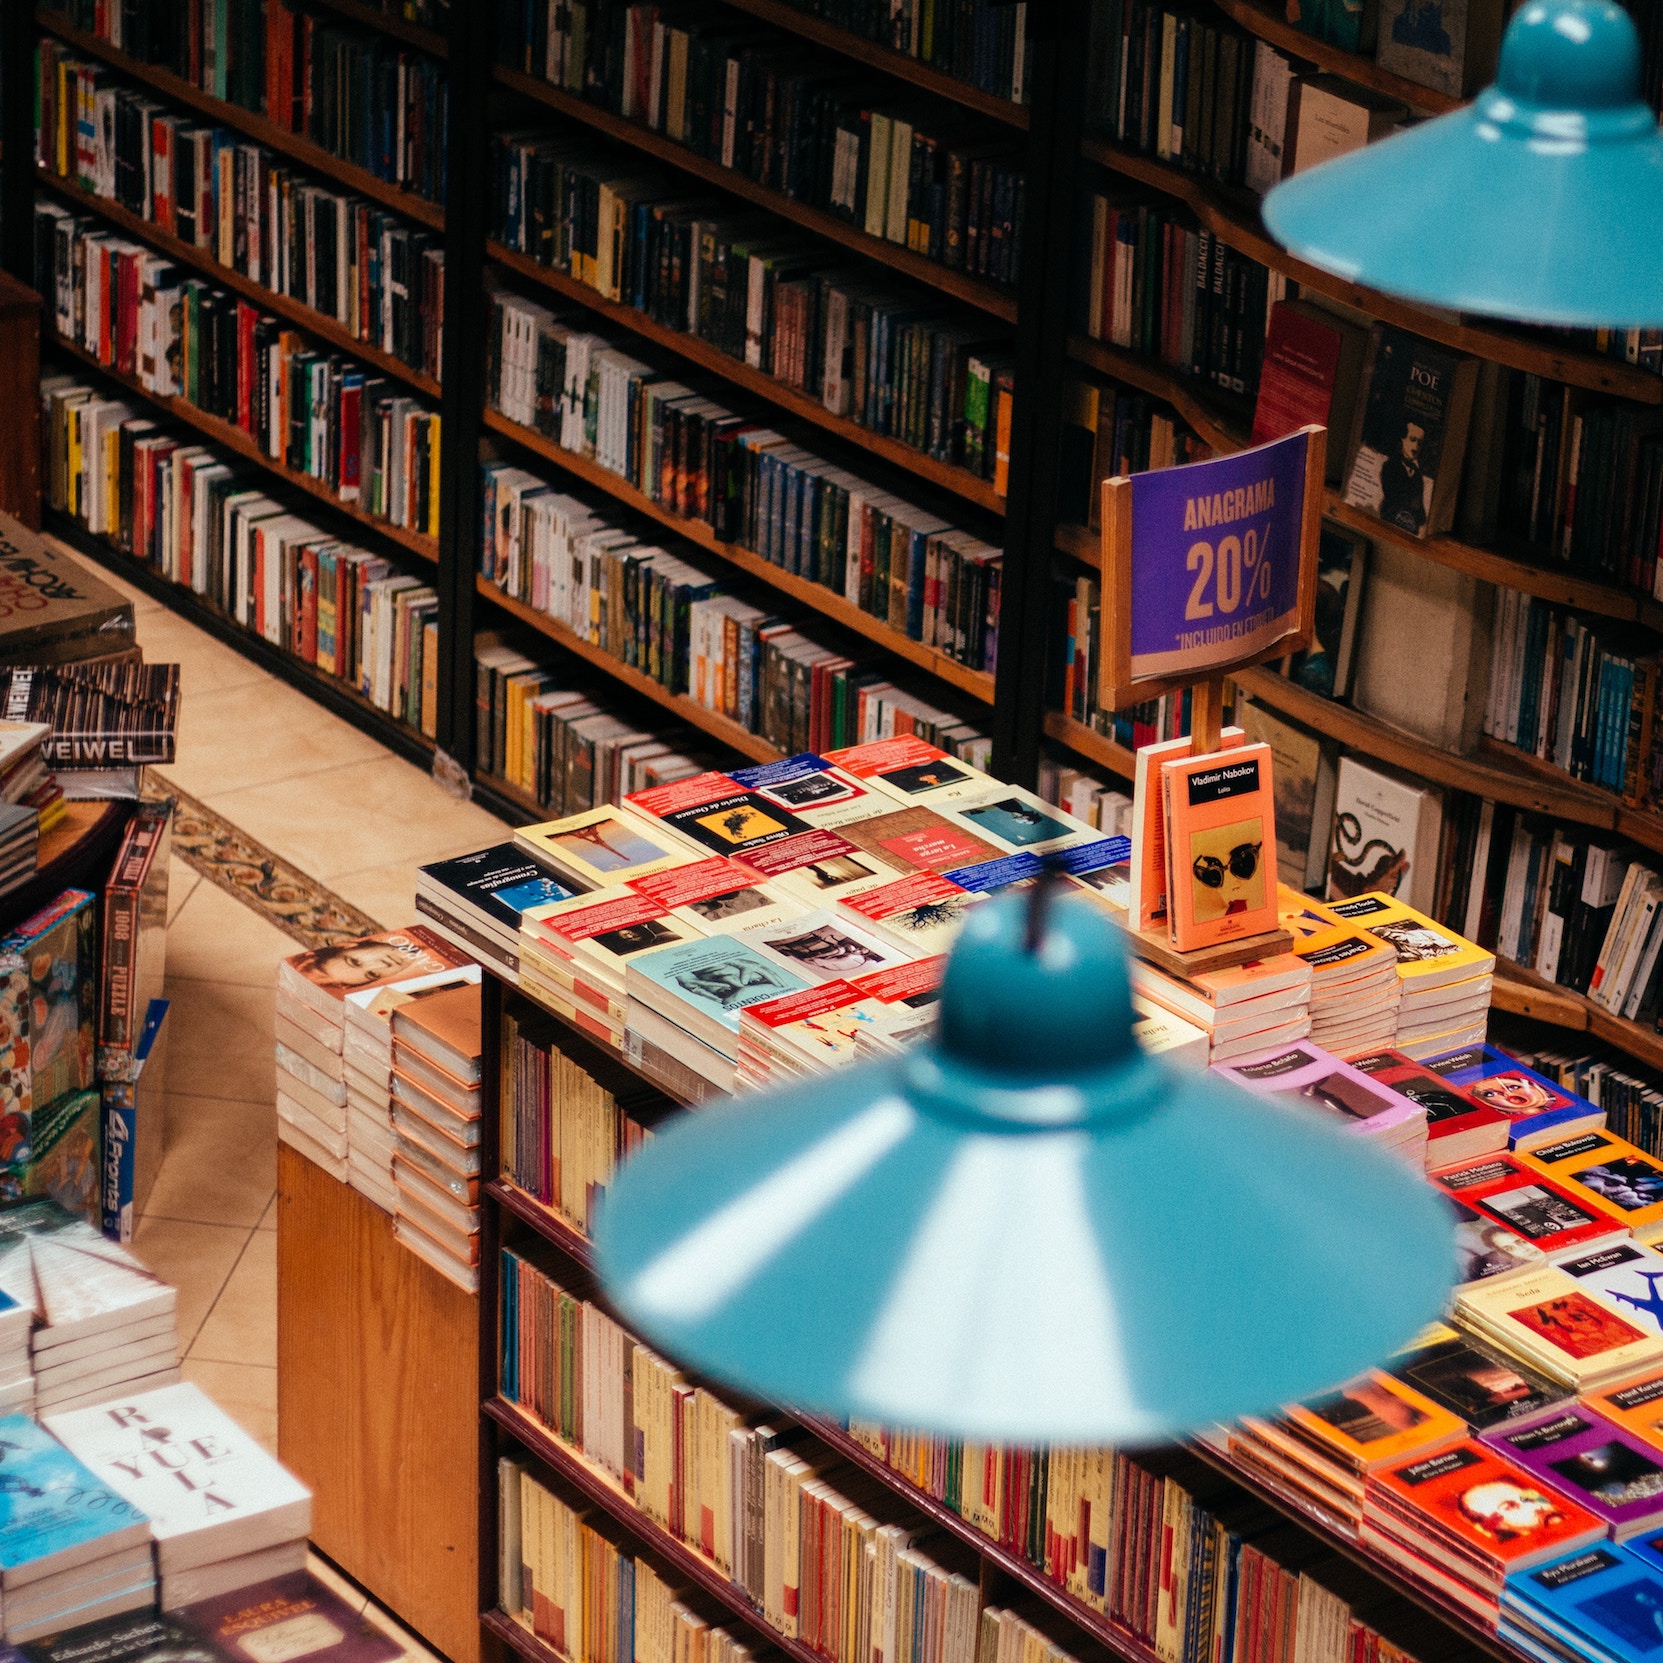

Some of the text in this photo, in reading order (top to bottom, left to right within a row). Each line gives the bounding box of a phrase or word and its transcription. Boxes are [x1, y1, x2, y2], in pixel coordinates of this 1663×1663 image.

[1213, 243, 1225, 294] BALDACCI
[1411, 366, 1440, 391] POE
[1184, 478, 1275, 531] ANAGRAMA
[1185, 522, 1272, 620] 20%
[1192, 767, 1255, 786] Vladimir Nabokov
[1218, 786, 1231, 794] Lolita
[721, 796, 749, 806] Diario
[675, 806, 708, 820] Oaxaca
[766, 831, 790, 841] Oliver
[115, 910, 130, 941] 1008
[388, 935, 446, 973] GARRO
[1339, 944, 1367, 958] Charles
[111, 966, 128, 1016] PUZZLE
[722, 993, 771, 1011] CUENTOS
[1271, 1053, 1298, 1067] Bolaño
[1449, 1053, 1473, 1063] Welsh
[1535, 1134, 1598, 1157] Charles Bukowski
[1443, 1169, 1470, 1182] Patrick
[1469, 1161, 1503, 1175] Modiano
[1577, 1252, 1622, 1270] Ian McEwan
[1516, 1287, 1541, 1299] Seda
[219, 1600, 317, 1635] ESQUIVEL
[224, 1598, 289, 1623] LAURA
[51, 1621, 163, 1663] Eduardo Sacheri
